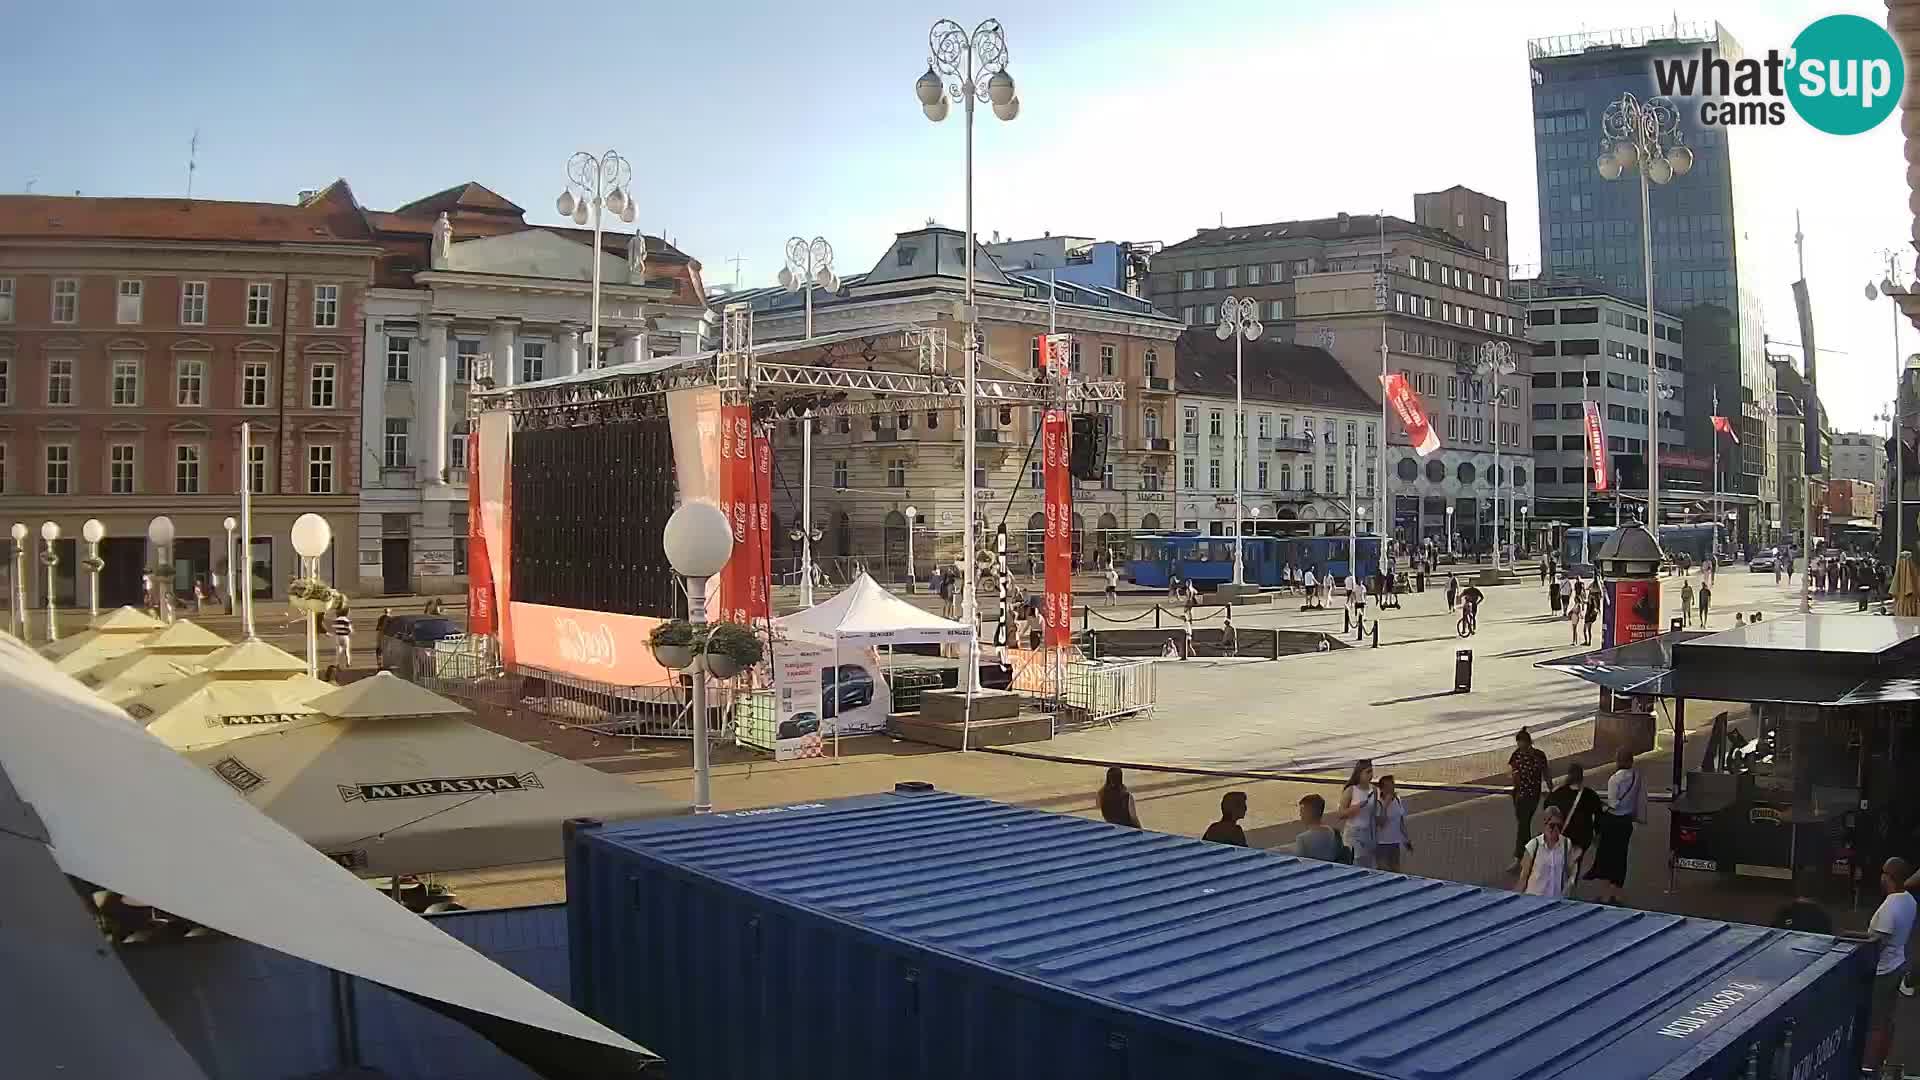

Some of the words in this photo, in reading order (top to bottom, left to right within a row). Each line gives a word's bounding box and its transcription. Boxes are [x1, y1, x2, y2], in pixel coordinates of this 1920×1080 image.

[734, 416, 747, 459] Coca-Cola
[734, 502, 746, 543] Coca-Cola
[1047, 503, 1056, 538] Coca-Cola
[1060, 503, 1069, 538] Coca-Cola
[1059, 592, 1069, 628] Coca-Cola
[370, 776, 515, 799] MARASKA
[1690, 989, 1745, 1018] 300629
